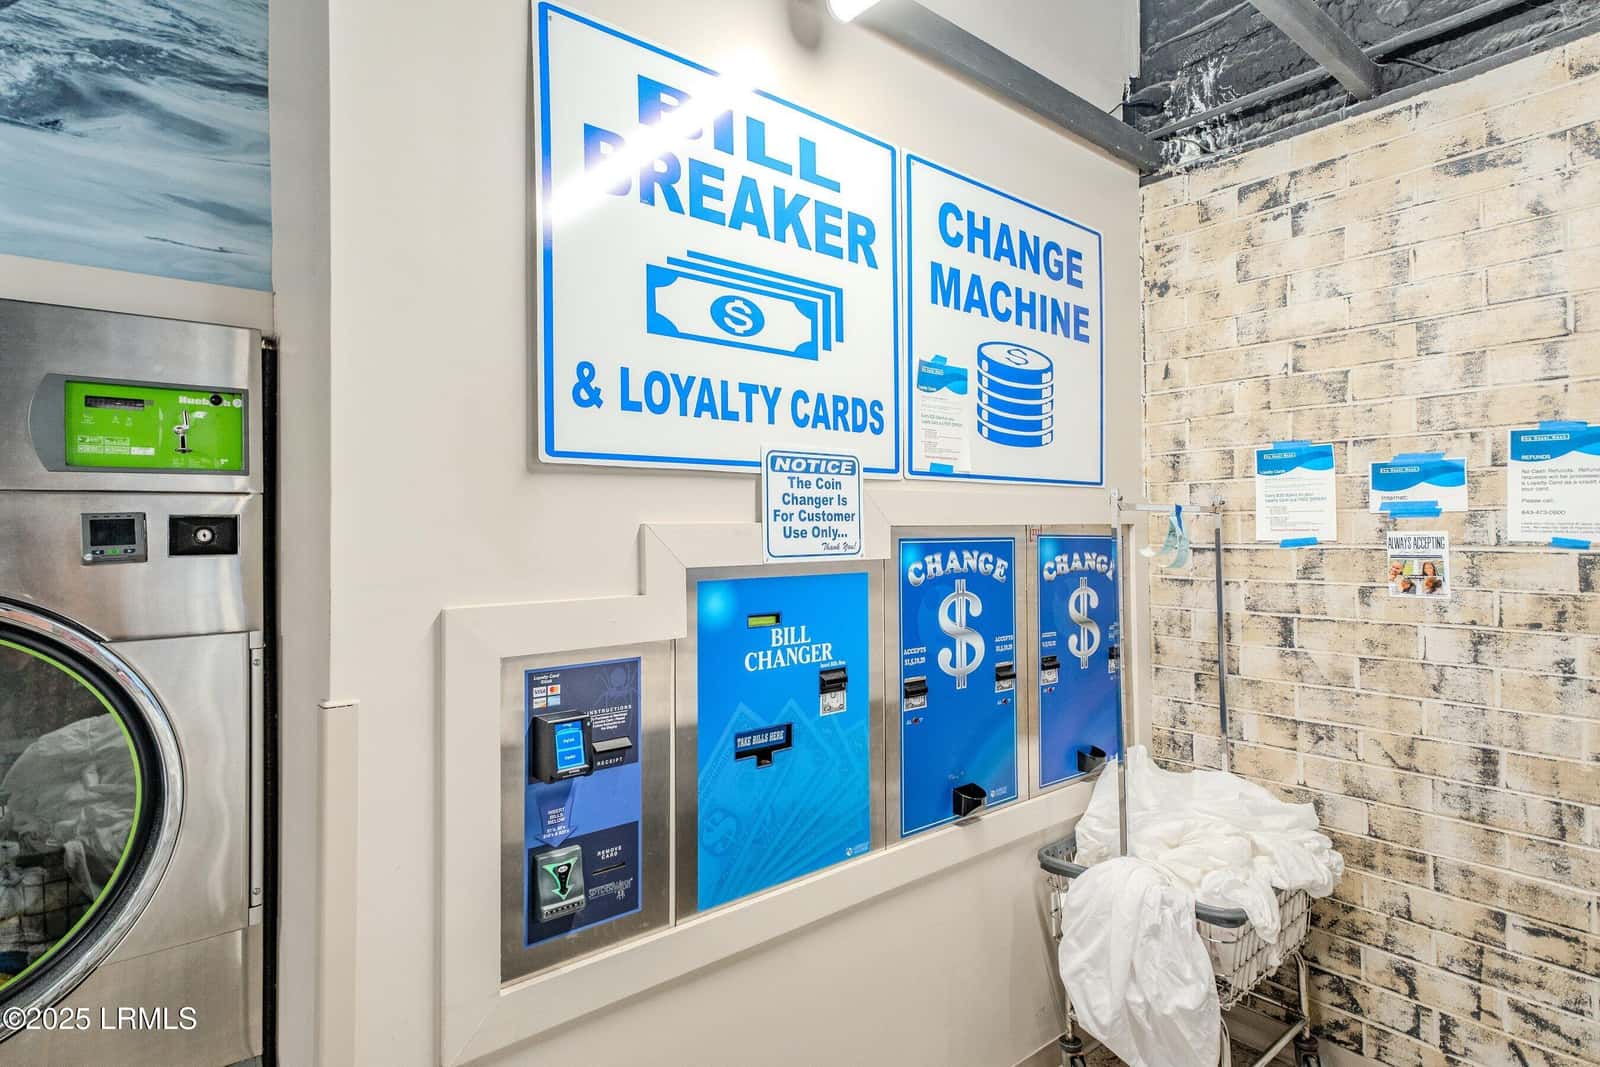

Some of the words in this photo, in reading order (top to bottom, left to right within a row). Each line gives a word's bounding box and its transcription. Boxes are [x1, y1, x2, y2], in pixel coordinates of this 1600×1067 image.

[938, 201, 1083, 289] CHANGE
[930, 260, 1090, 344] MACHINE
[572, 361, 603, 409] &
[620, 366, 781, 425] LOYALTY
[791, 389, 885, 435] CARDS
[774, 457, 854, 474] NOTICE
[787, 476, 812, 489] The
[816, 477, 842, 490] Coin
[782, 493, 834, 509] Changer
[838, 494, 848, 506] Is
[773, 509, 794, 522] For
[798, 509, 856, 522] Customer
[783, 526, 808, 539] Use
[812, 526, 848, 541] Only...
[1388, 536, 1412, 549] ALWAYS
[1413, 536, 1446, 550] ACCEPTING
[908, 550, 1008, 586] CHANGE
[771, 625, 811, 647] BILL
[744, 642, 833, 672] CHANGER
[904, 647, 926, 655] ACCEPTS
[737, 736, 751, 748] TAKE
[752, 733, 769, 745] BILLS
[769, 729, 785, 741] HERE
[596, 757, 623, 766] RECEIPT
[597, 845, 622, 856] REMOVE
[601, 851, 618, 860] CARD
